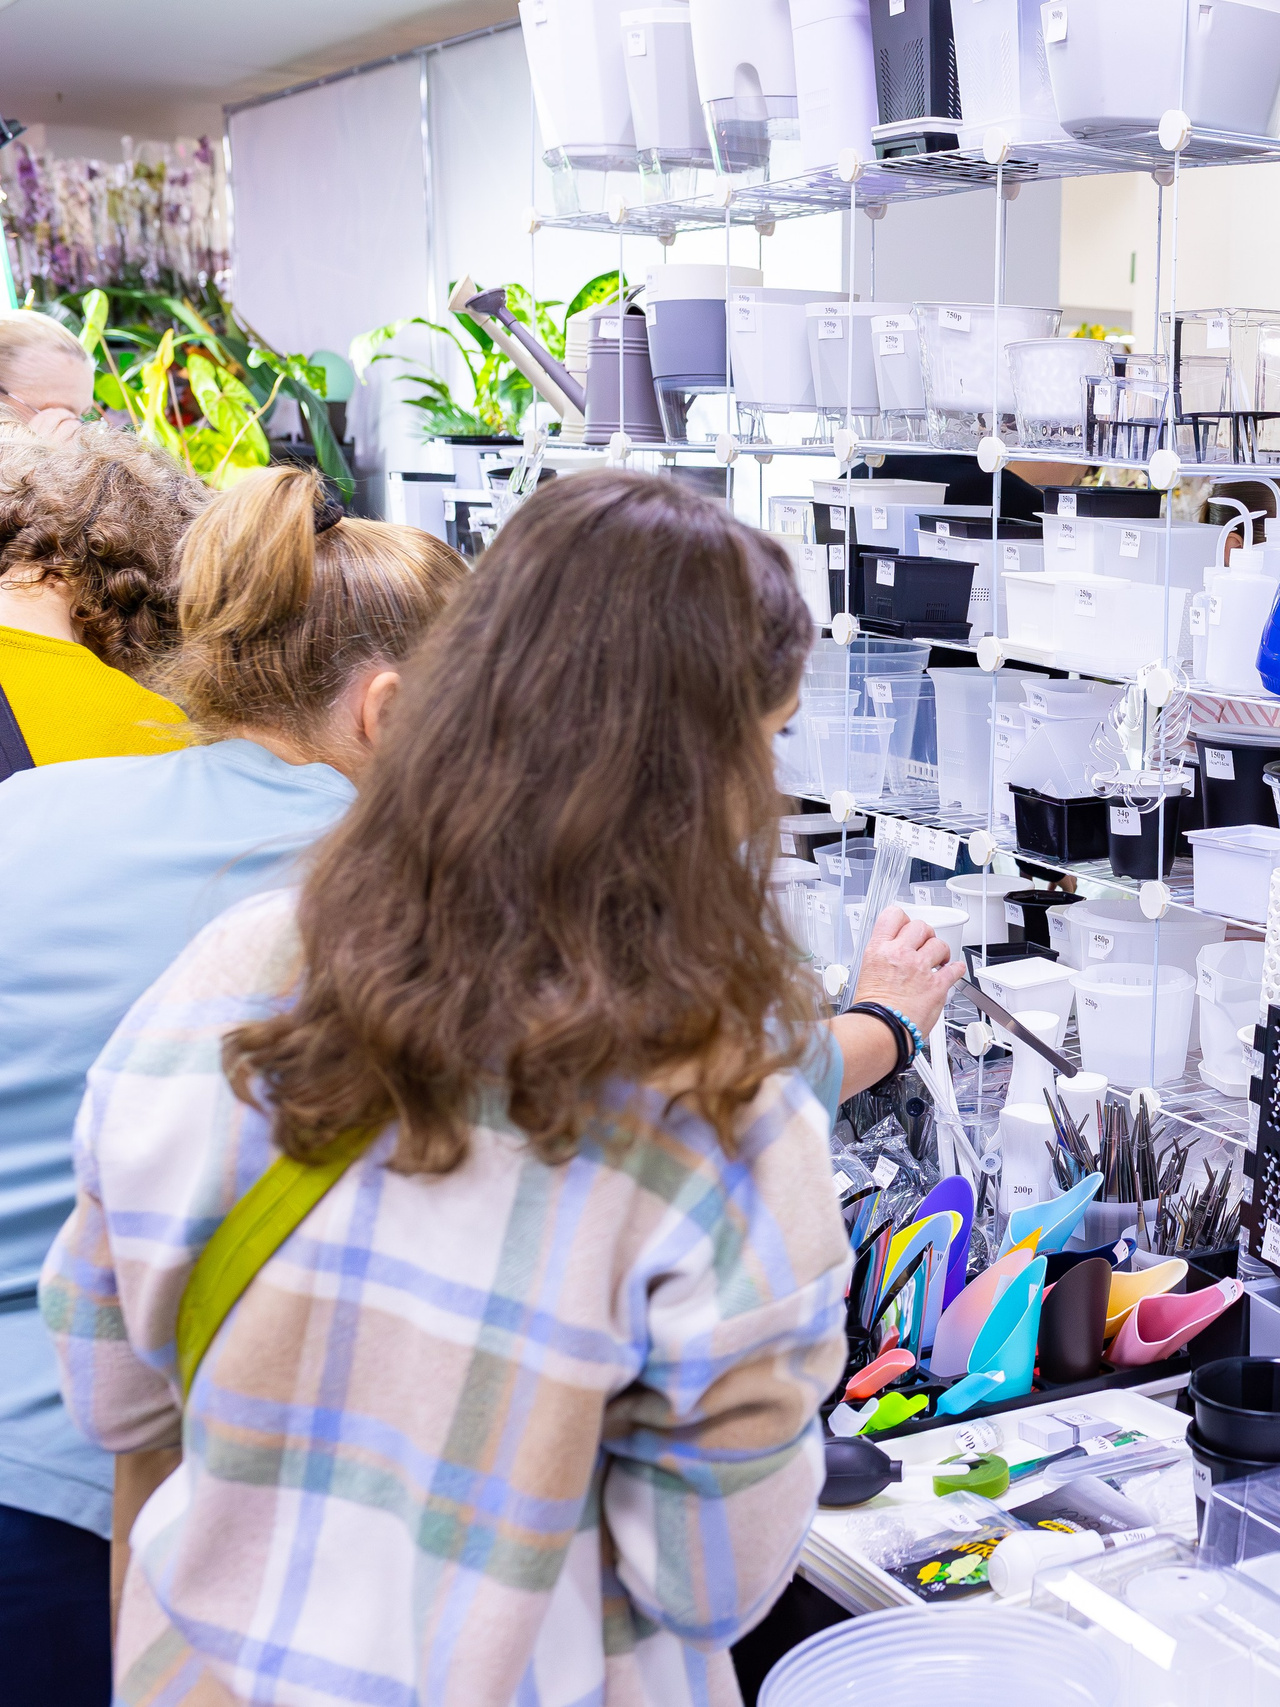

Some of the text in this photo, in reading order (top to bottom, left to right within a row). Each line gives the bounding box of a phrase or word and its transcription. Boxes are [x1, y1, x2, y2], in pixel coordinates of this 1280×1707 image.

[946, 311, 962, 322] 750р
[823, 321, 837, 329] 350р
[885, 320, 899, 329] 250р
[885, 336, 898, 344] 250р
[784, 506, 797, 515] 250р
[1062, 523, 1073, 533] 350р
[1125, 531, 1138, 541] 350р
[1079, 589, 1092, 600] 250р
[1210, 750, 1226, 761] 150р
[1116, 809, 1130, 819] 34р
[1093, 934, 1110, 945] 450р
[1084, 998, 1098, 1010] 250р
[1013, 1186, 1033, 1195] 200р
[960, 1430, 976, 1450] 10р
